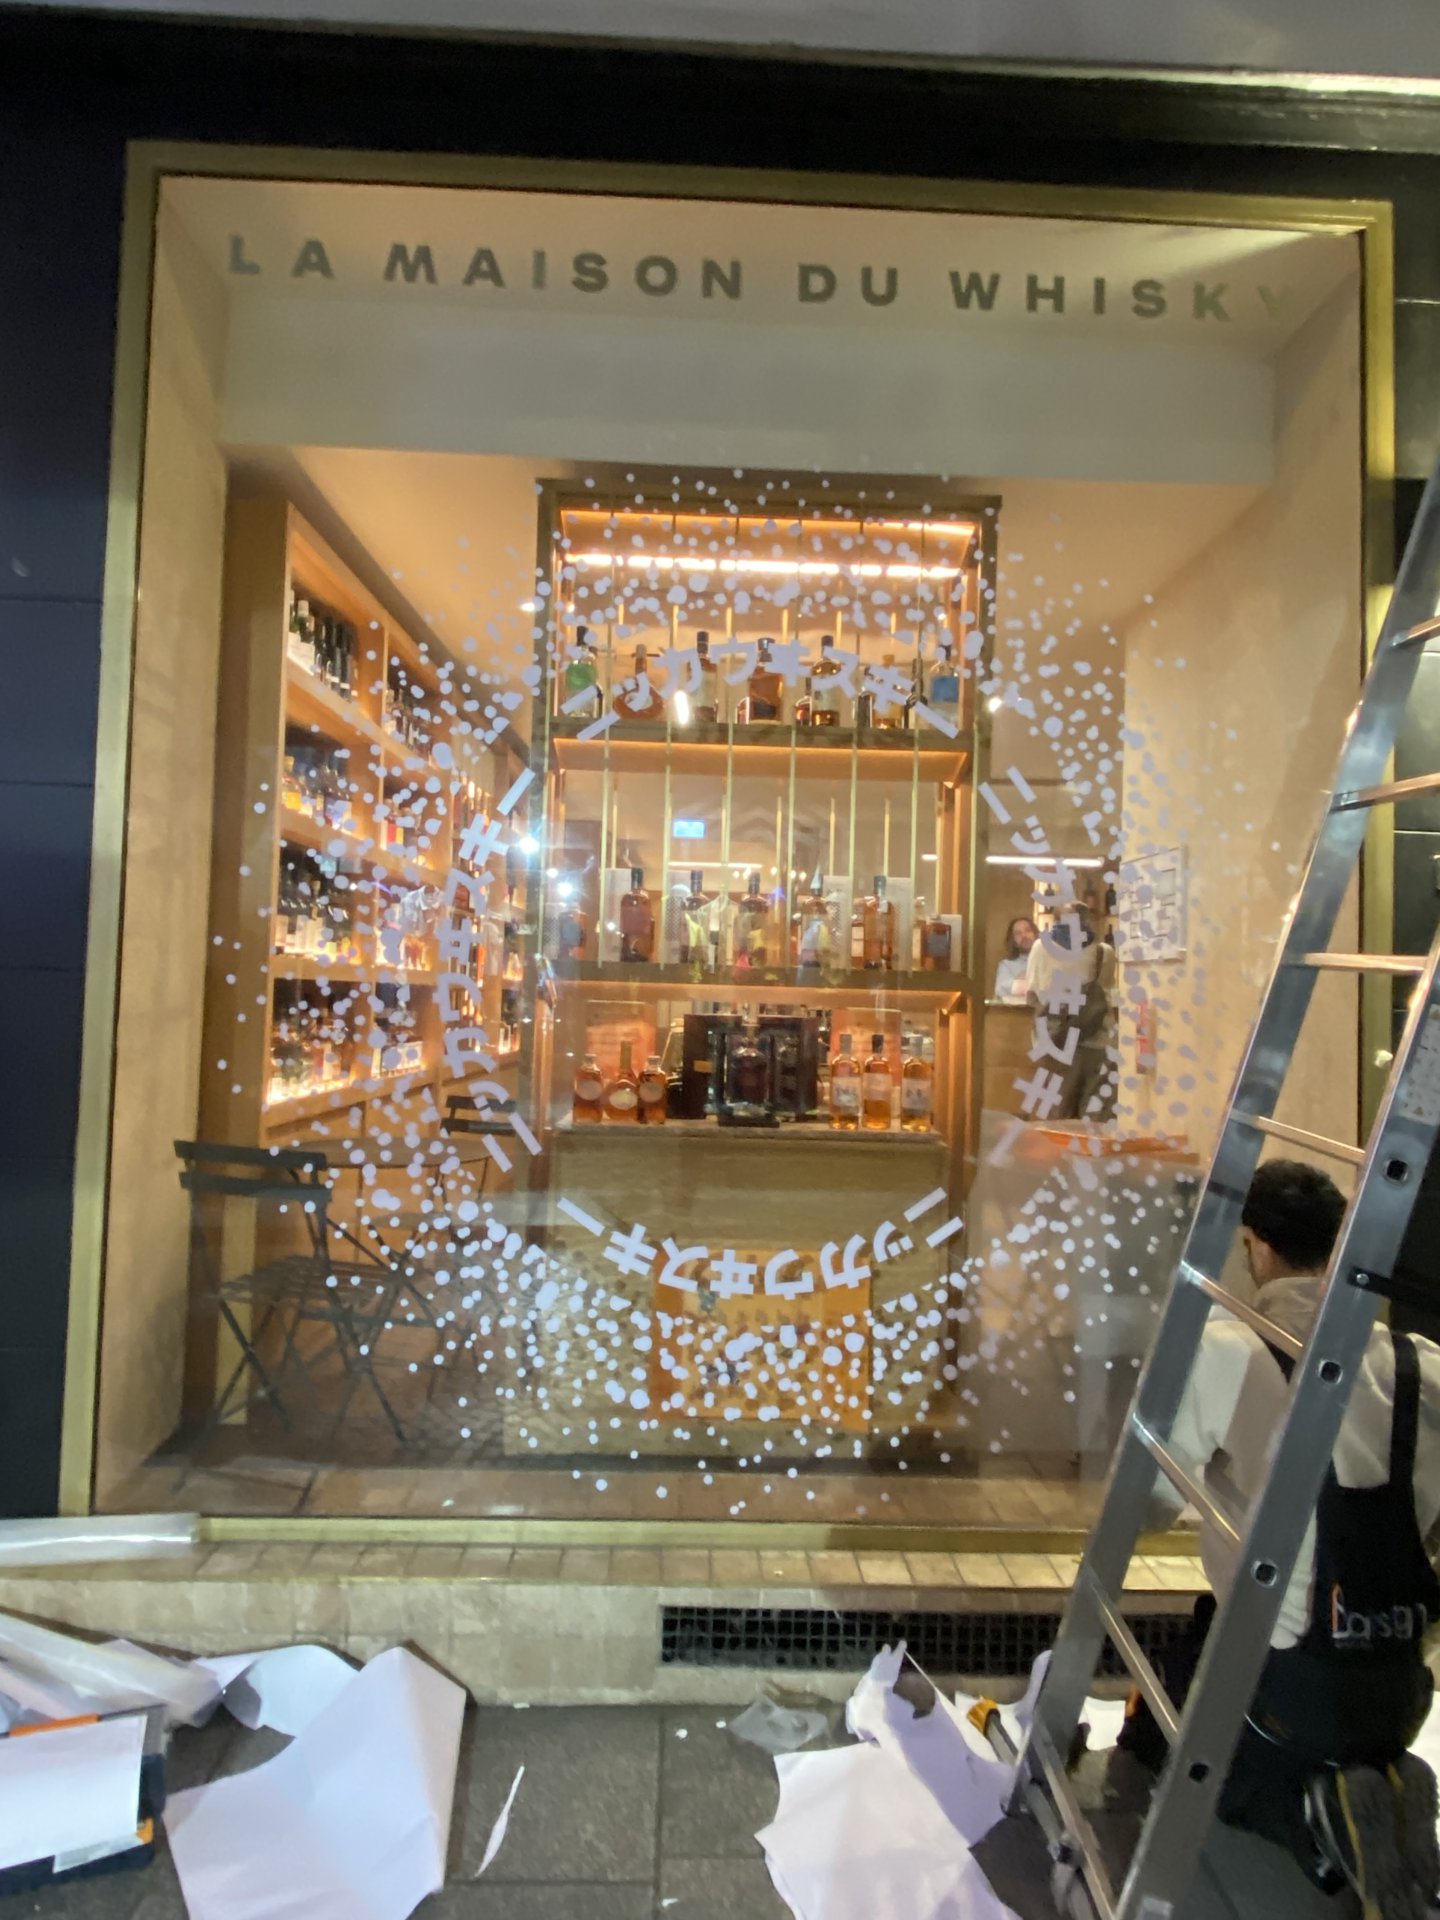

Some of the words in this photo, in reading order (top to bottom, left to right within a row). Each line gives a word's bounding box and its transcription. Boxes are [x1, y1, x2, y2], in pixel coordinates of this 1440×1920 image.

[228, 235, 334, 279] LA
[383, 243, 742, 299] MAISON
[797, 263, 898, 307] DU
[949, 270, 1291, 322] WHISKY
